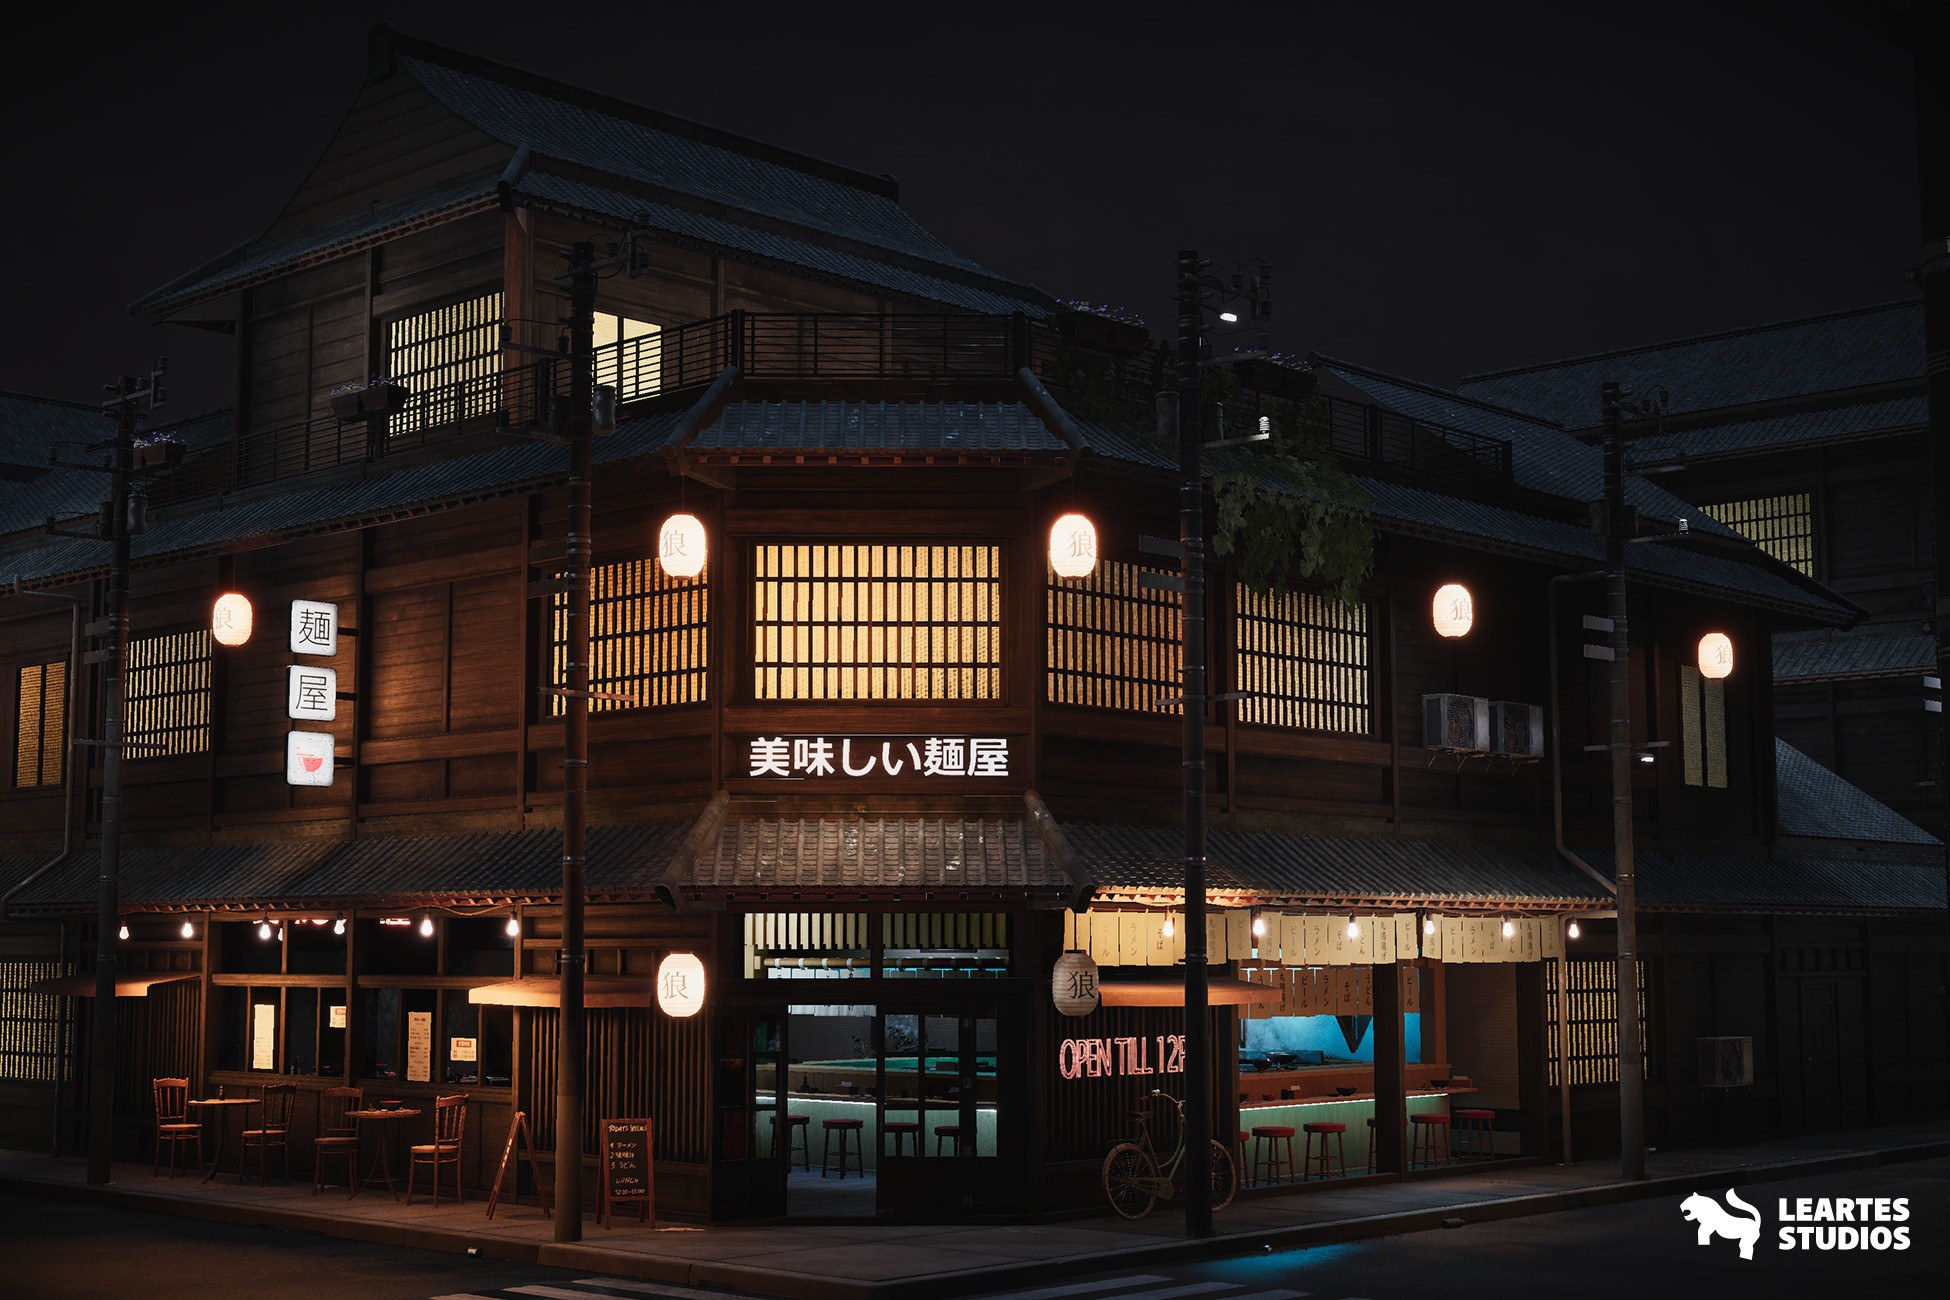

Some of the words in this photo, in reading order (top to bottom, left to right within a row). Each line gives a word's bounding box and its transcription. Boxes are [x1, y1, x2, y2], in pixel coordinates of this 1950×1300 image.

[662, 529, 688, 558] 狼
[1066, 530, 1094, 558] 狼
[749, 736, 1009, 777] 美味しい麺屋
[661, 971, 689, 1000] 狼
[1067, 971, 1095, 999] 狼
[1059, 1038, 1112, 1080] OPEN
[1114, 1036, 1153, 1075] TILL
